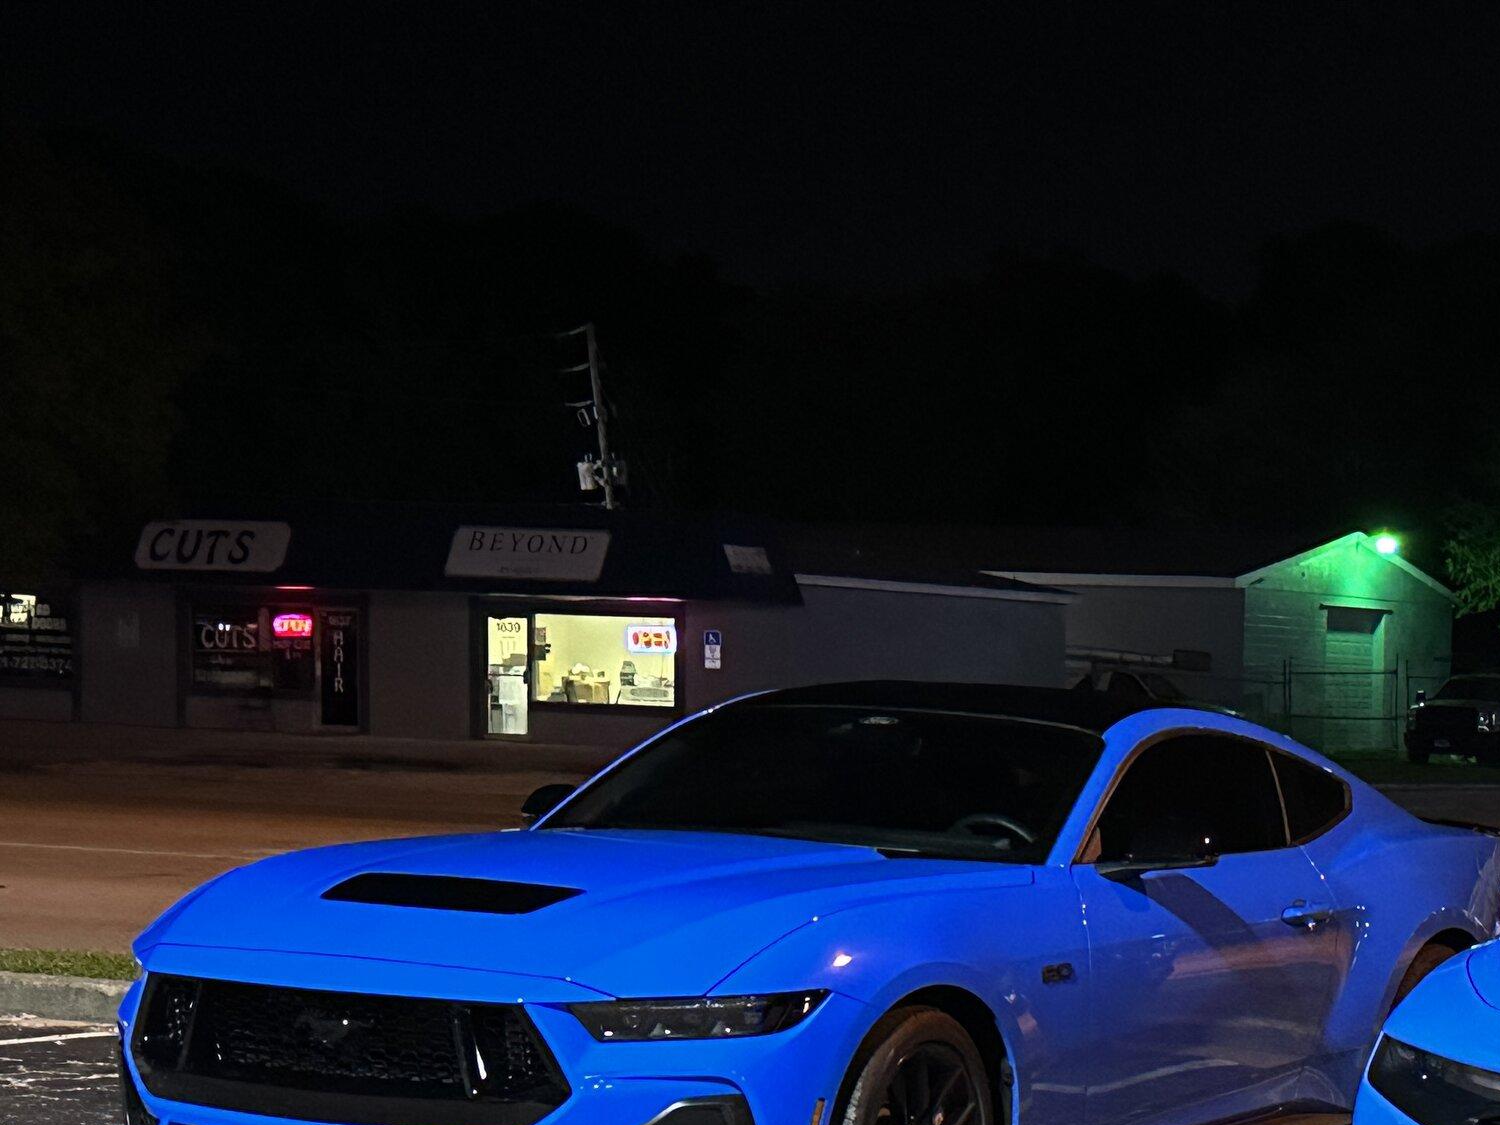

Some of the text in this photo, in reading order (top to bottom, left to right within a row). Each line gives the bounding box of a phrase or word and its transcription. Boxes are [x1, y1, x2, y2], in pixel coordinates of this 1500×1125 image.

[150, 528, 255, 564] CUTS
[469, 531, 588, 554] BEYOND
[201, 623, 257, 649] CUTS
[333, 630, 344, 694] HAIR
